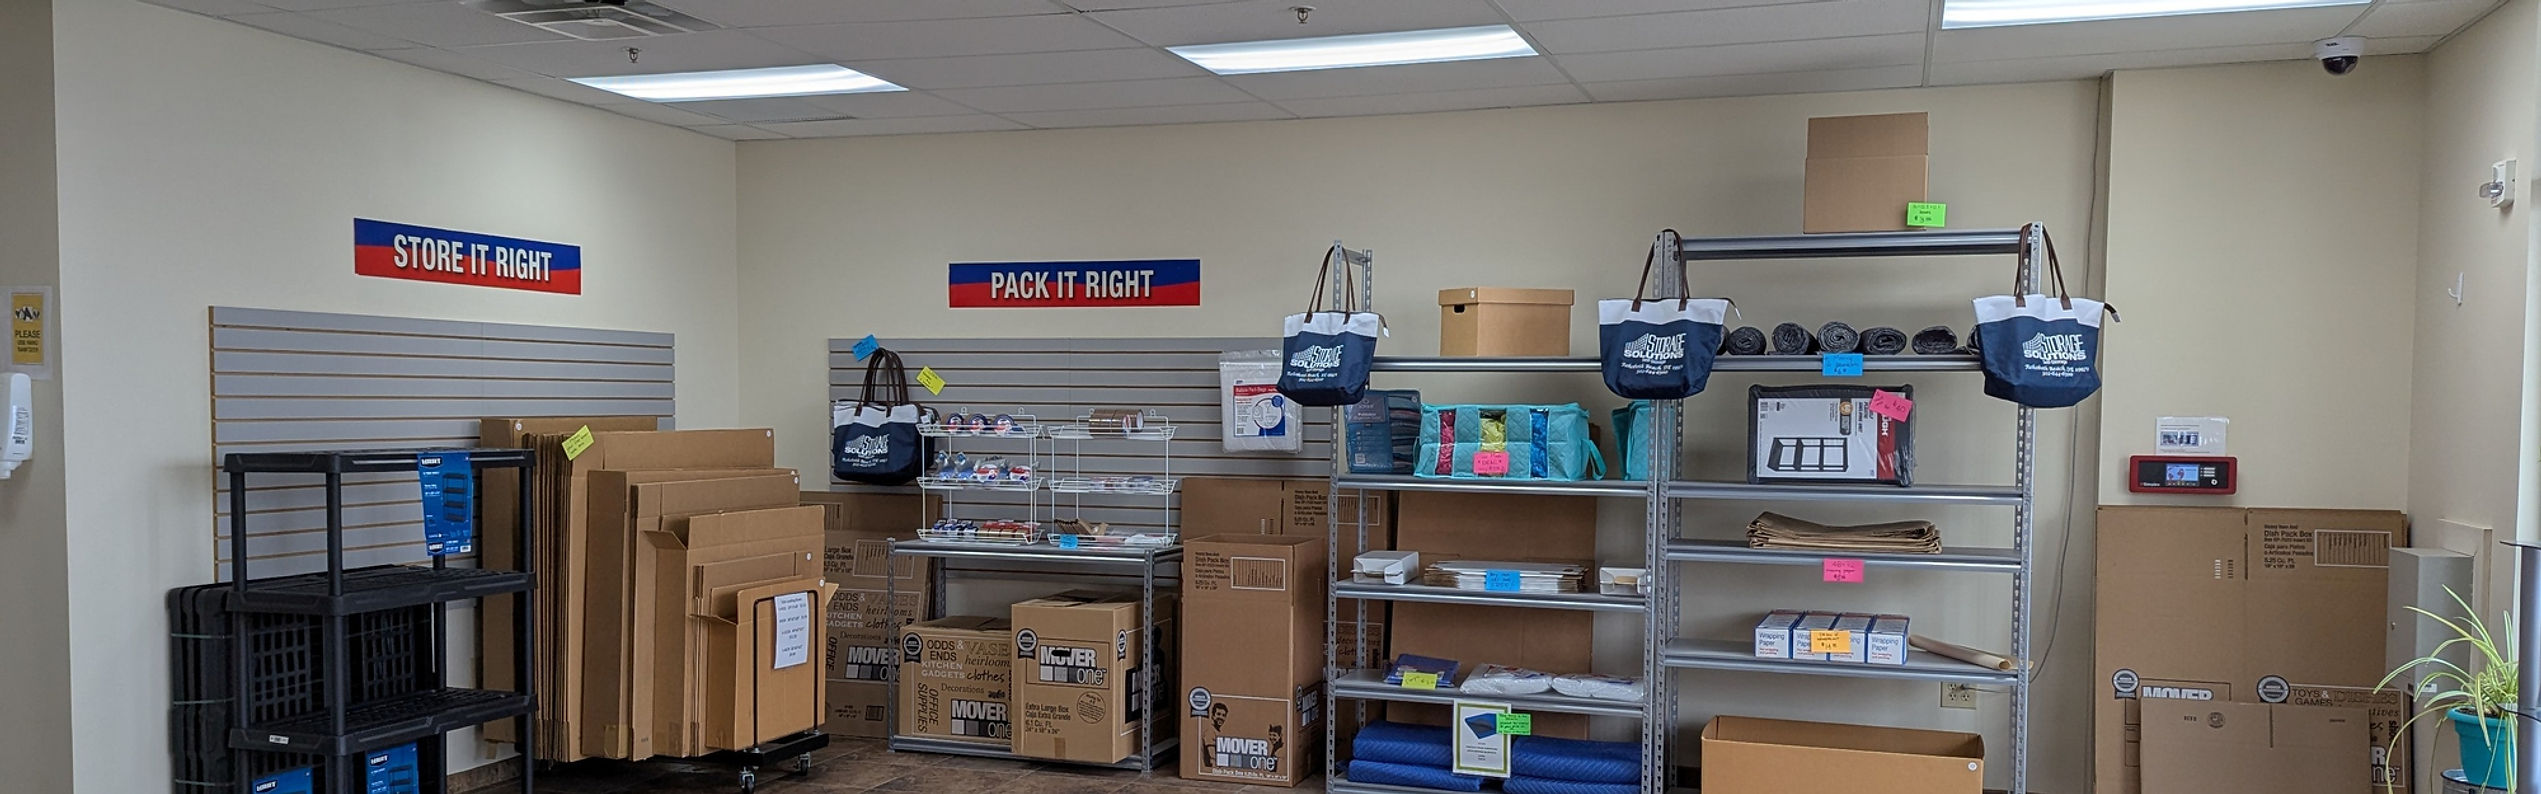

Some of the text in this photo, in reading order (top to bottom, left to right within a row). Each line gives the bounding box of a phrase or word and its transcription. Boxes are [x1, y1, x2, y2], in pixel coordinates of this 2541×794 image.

[393, 233, 552, 282] STORE IT RIGHT
[991, 269, 1155, 299] PACK IT RIGHT
[15, 330, 41, 338] PLEASE
[2040, 333, 2084, 353] STORAGE
[1623, 349, 1684, 360] SOLUTIONS
[2023, 349, 2087, 360] SOLUTIONS
[833, 602, 859, 611] ENDS
[826, 620, 864, 628] ADGETS
[1759, 632, 1785, 641] Wrapping
[1871, 636, 1899, 646] Wrapping
[927, 640, 1012, 656] ODDS & VASE
[930, 651, 957, 661] ENDS
[964, 655, 1012, 667] heirloom
[1040, 645, 1097, 667] MOVER
[921, 661, 963, 670] KITCHEN
[921, 670, 966, 679] GADGETS
[966, 669, 1005, 683] clothes
[941, 683, 985, 694] Decorations
[2292, 688, 2320, 698] TOYS
[2321, 690, 2330, 699] &
[929, 688, 939, 726] OFFICE
[2294, 697, 2334, 706] GAMES
[918, 682, 928, 733] SUPPLIES
[951, 700, 1008, 721] MOVER
[1041, 704, 1057, 713] Large
[1058, 705, 1069, 713] Box
[987, 722, 1012, 739] one
[1216, 736, 1268, 756] MOVER
